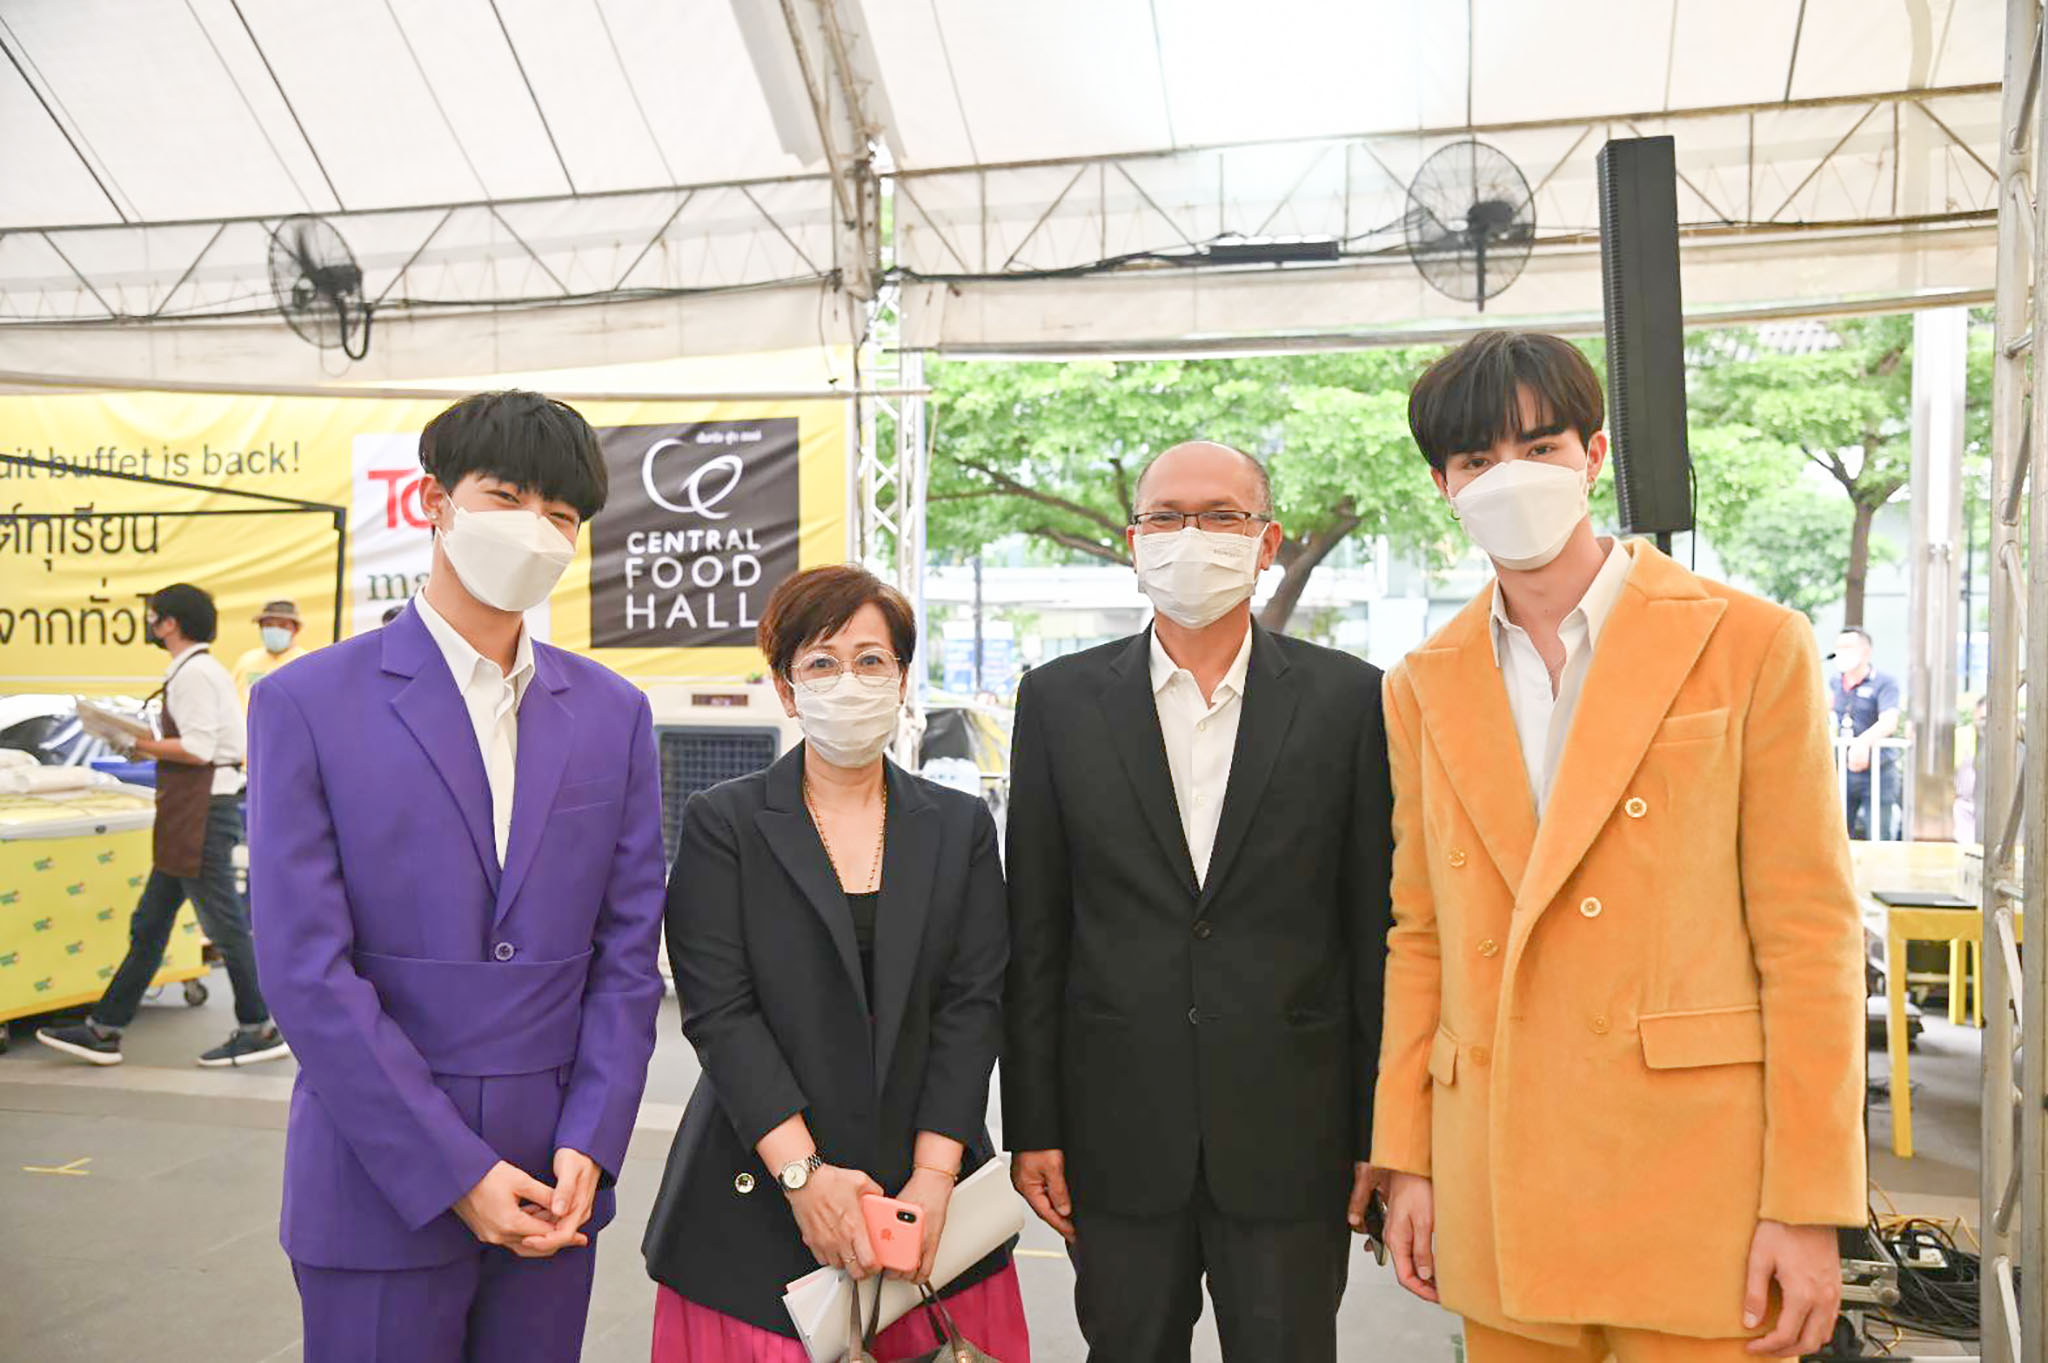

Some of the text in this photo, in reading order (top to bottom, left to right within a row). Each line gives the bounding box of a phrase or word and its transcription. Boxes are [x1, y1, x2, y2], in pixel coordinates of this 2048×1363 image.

[49, 446, 151, 480] buffet
[163, 445, 190, 478] is
[203, 440, 300, 476] back!
[626, 527, 761, 555] CENTRAL
[625, 554, 762, 589] FOOD
[626, 592, 759, 630] HALL
